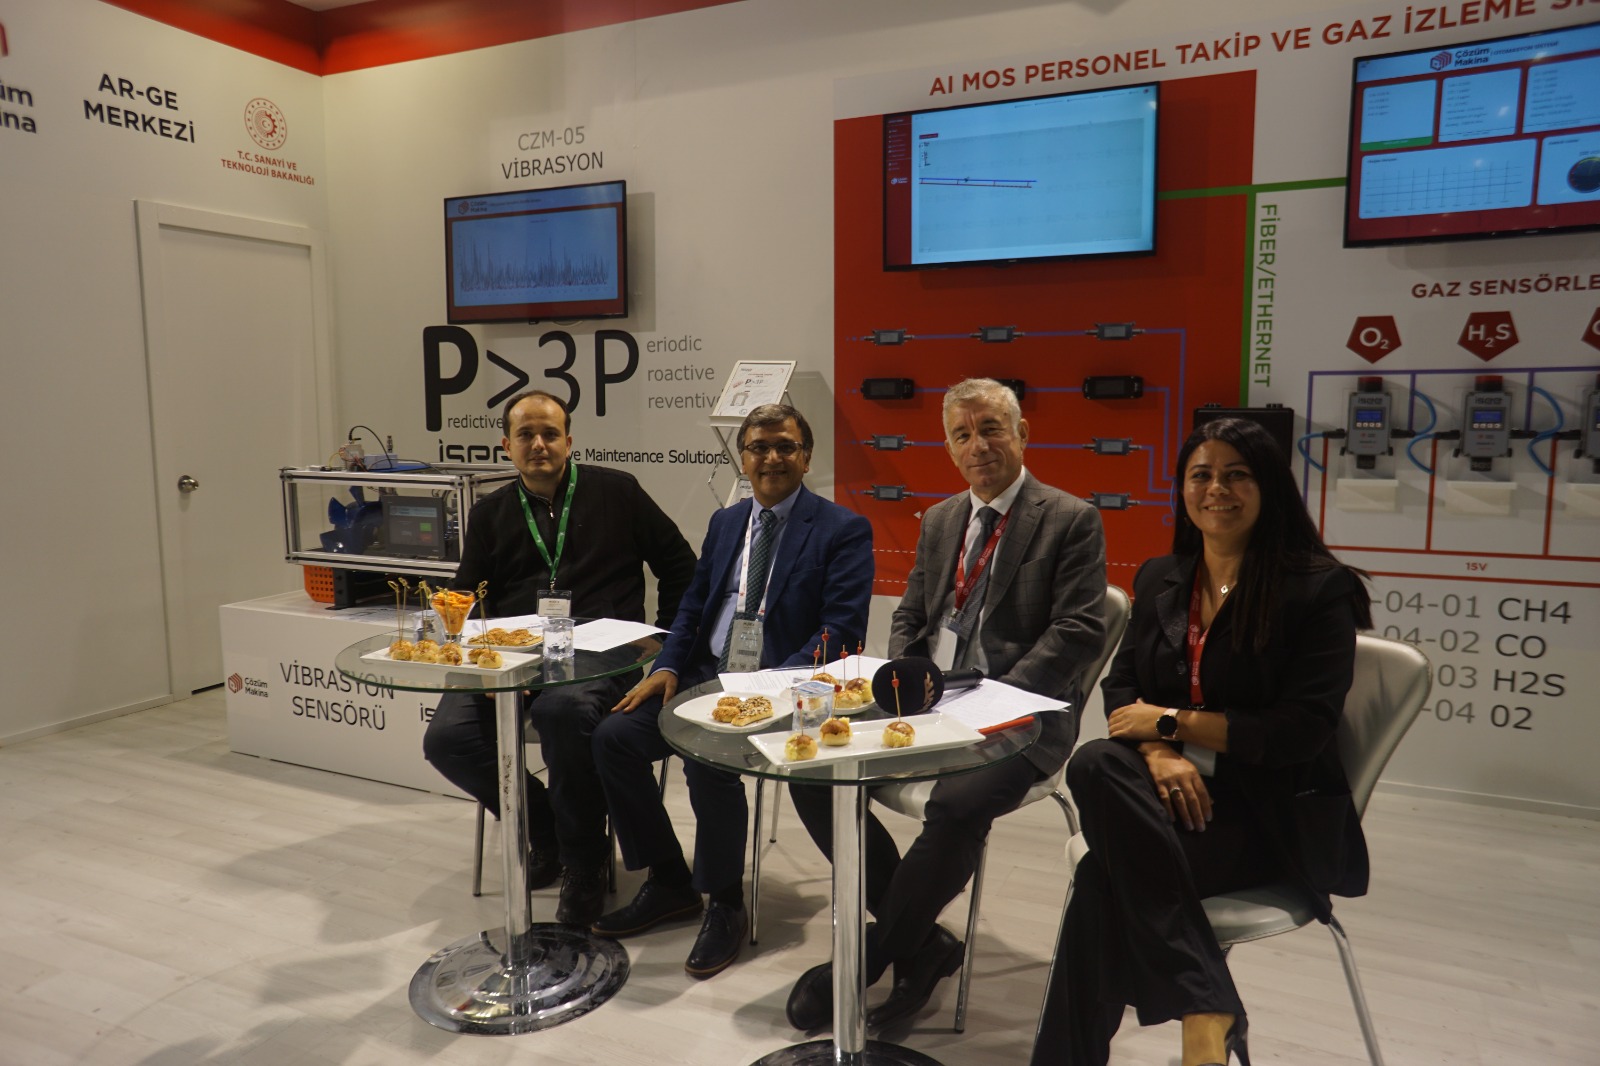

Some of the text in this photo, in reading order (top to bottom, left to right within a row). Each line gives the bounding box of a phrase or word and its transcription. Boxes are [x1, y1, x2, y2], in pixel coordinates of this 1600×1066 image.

[930, 0, 1537, 96] AI MOS PERSONEL TAKİP VE GAZ İZLEME
[1455, 48, 1490, 58] Çözüm
[1455, 57, 1489, 67] Makina
[98, 73, 179, 111] AR-GE
[83, 99, 195, 144] MERKEZİ
[518, 126, 586, 151] CZM-05
[221, 158, 315, 186] TEKNOLOJİ BAKANLIĞI
[237, 151, 297, 171] T.C. SANAYİ VE
[501, 151, 604, 180] VİBRASYON
[1254, 203, 1281, 388] FİBER/ETHERNET
[1411, 273, 1600, 298] GAZ SENSÖRLE
[646, 335, 703, 354] eriodic
[1467, 322, 1511, 347] H2S
[647, 364, 716, 383] roactive
[447, 414, 503, 430] redictive
[585, 448, 664, 464] Maintenance
[668, 450, 731, 466] Solutions
[1465, 561, 1488, 572] 15V
[1498, 598, 1572, 625] CH4
[1495, 633, 1547, 659] CO
[244, 677, 268, 689] Çözüm
[245, 685, 269, 698] Makina
[280, 660, 394, 700] VİBRASYON
[1493, 669, 1566, 698] H2S
[292, 696, 386, 731] SENSÖRÜ
[1490, 704, 1533, 731] 02
